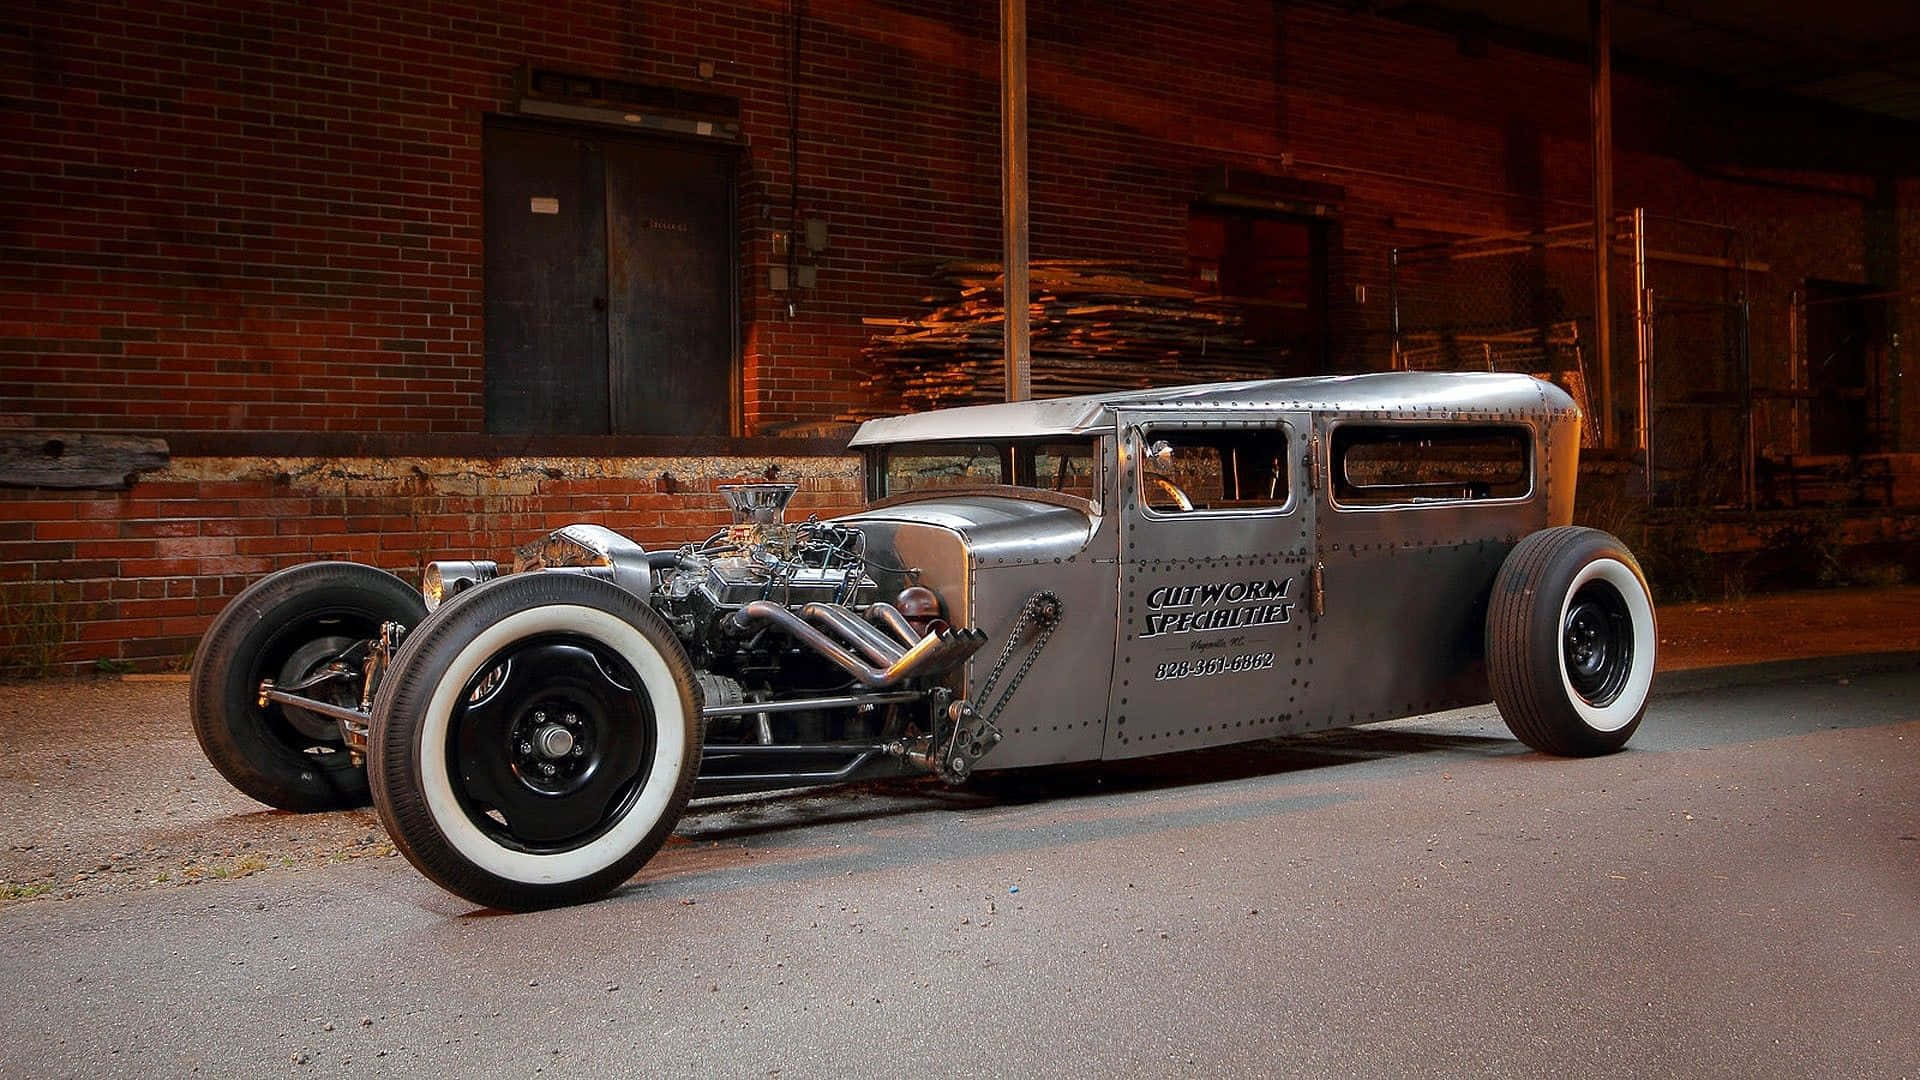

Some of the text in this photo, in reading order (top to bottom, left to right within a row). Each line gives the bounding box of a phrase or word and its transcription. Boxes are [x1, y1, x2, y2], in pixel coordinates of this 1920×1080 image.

[1146, 577, 1294, 610] CUTWORM
[1139, 602, 1296, 638] SPECIALTIES
[1155, 652, 1275, 681] 828-361-6862
